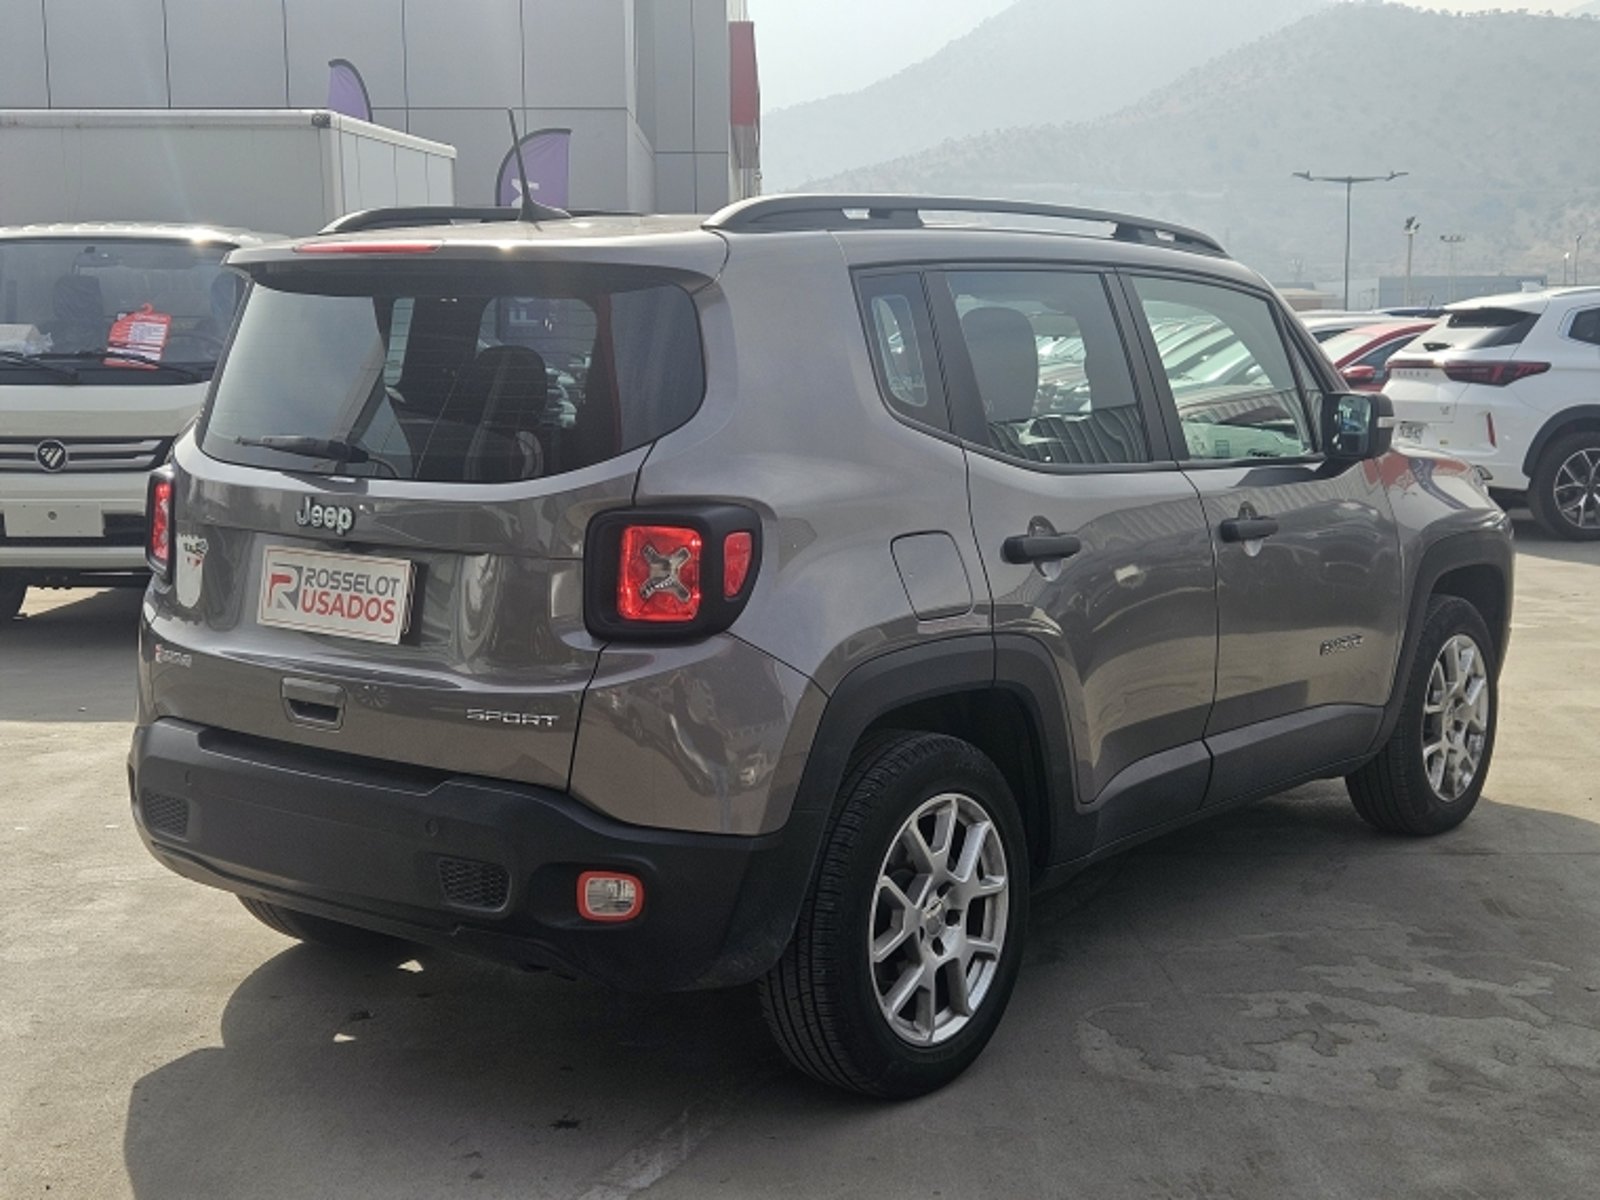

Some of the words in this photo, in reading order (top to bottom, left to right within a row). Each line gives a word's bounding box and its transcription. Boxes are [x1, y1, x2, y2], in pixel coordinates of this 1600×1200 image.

[296, 496, 354, 536] Jeep
[303, 567, 401, 598] ROSSELOT
[301, 589, 397, 624] USADOS
[466, 708, 560, 727] SPORT
